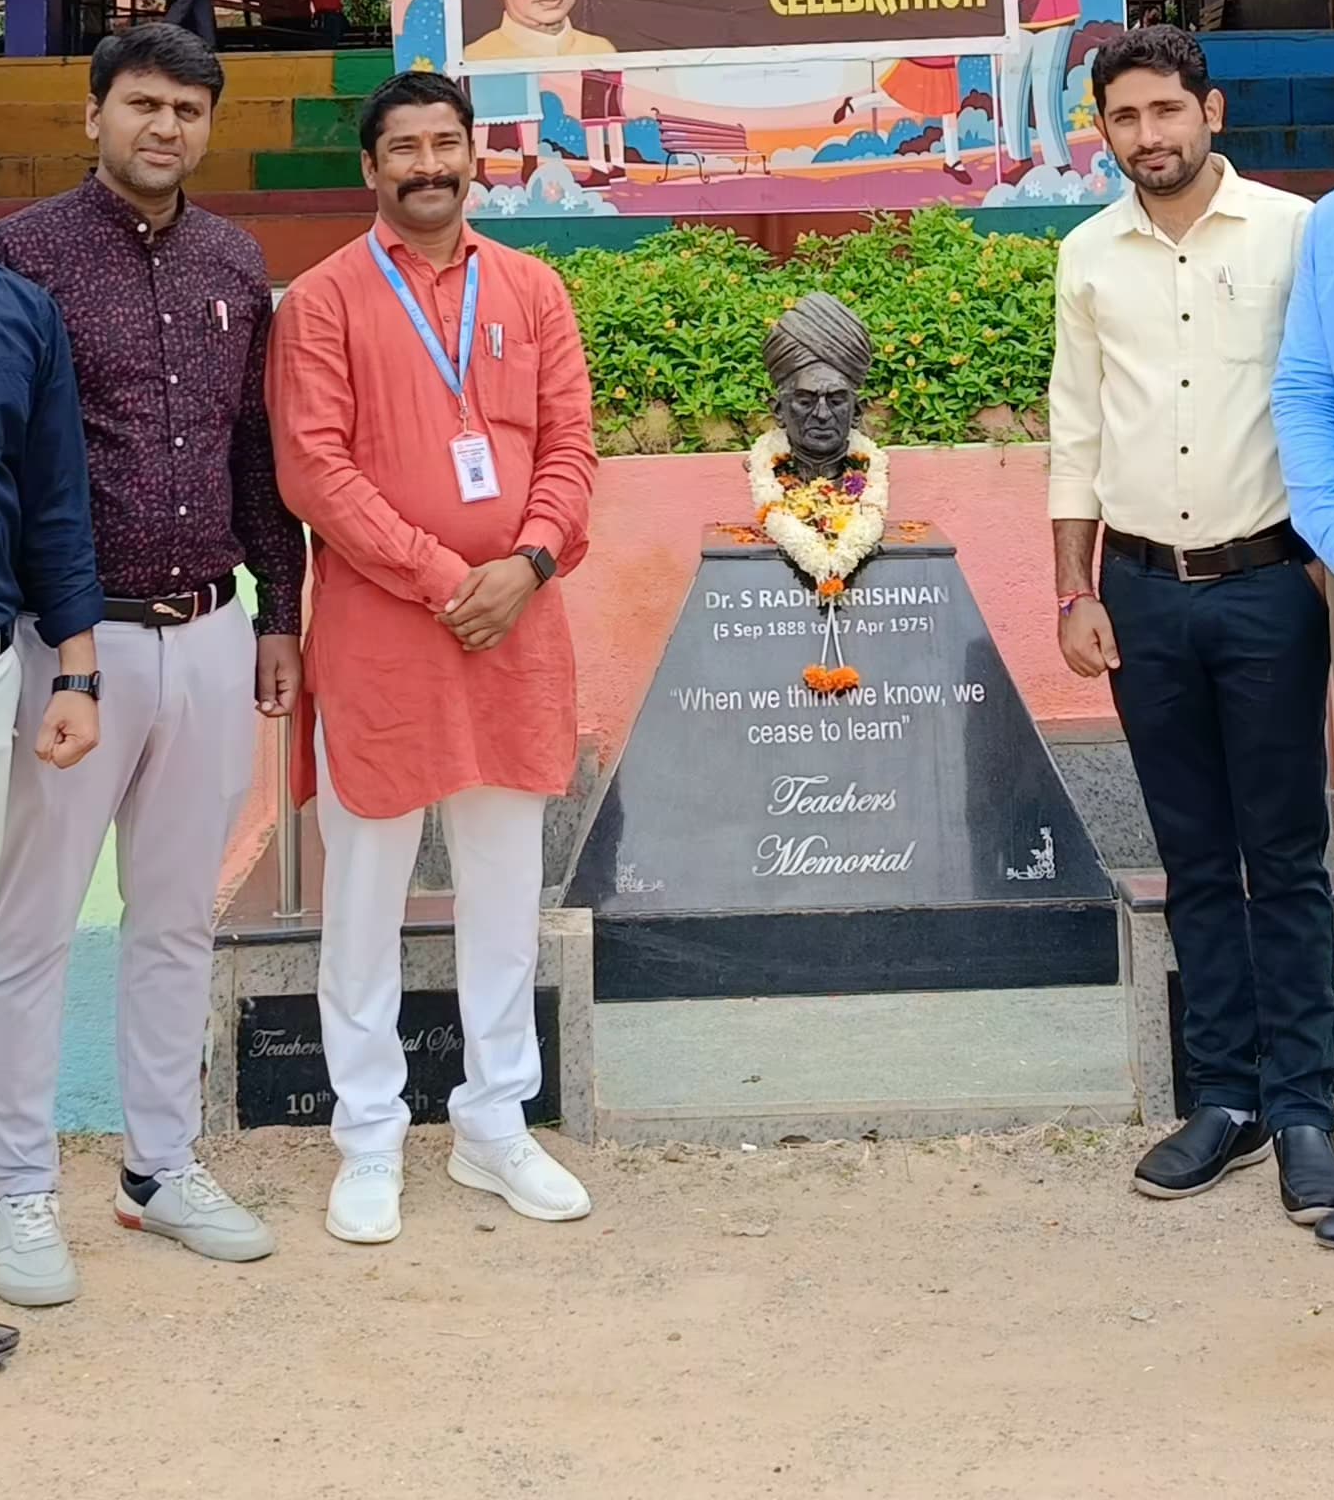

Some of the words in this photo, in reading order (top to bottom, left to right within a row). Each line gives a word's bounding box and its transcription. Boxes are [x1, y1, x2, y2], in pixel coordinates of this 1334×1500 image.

[705, 591, 734, 609] Dr.
[740, 591, 753, 609] S
[713, 622, 729, 640] (5
[734, 622, 763, 639] Sep
[767, 621, 806, 636] 1888
[811, 621, 828, 635] to
[856, 618, 884, 636] Apr
[890, 616, 935, 634] 1975)
[748, 690, 780, 709] we
[786, 684, 840, 708] think
[846, 686, 877, 706] we
[883, 681, 947, 706] know,
[952, 683, 987, 703] we
[748, 724, 814, 744] cease
[819, 718, 841, 741] to
[767, 775, 896, 816] Teachers
[752, 834, 916, 877] Memorial
